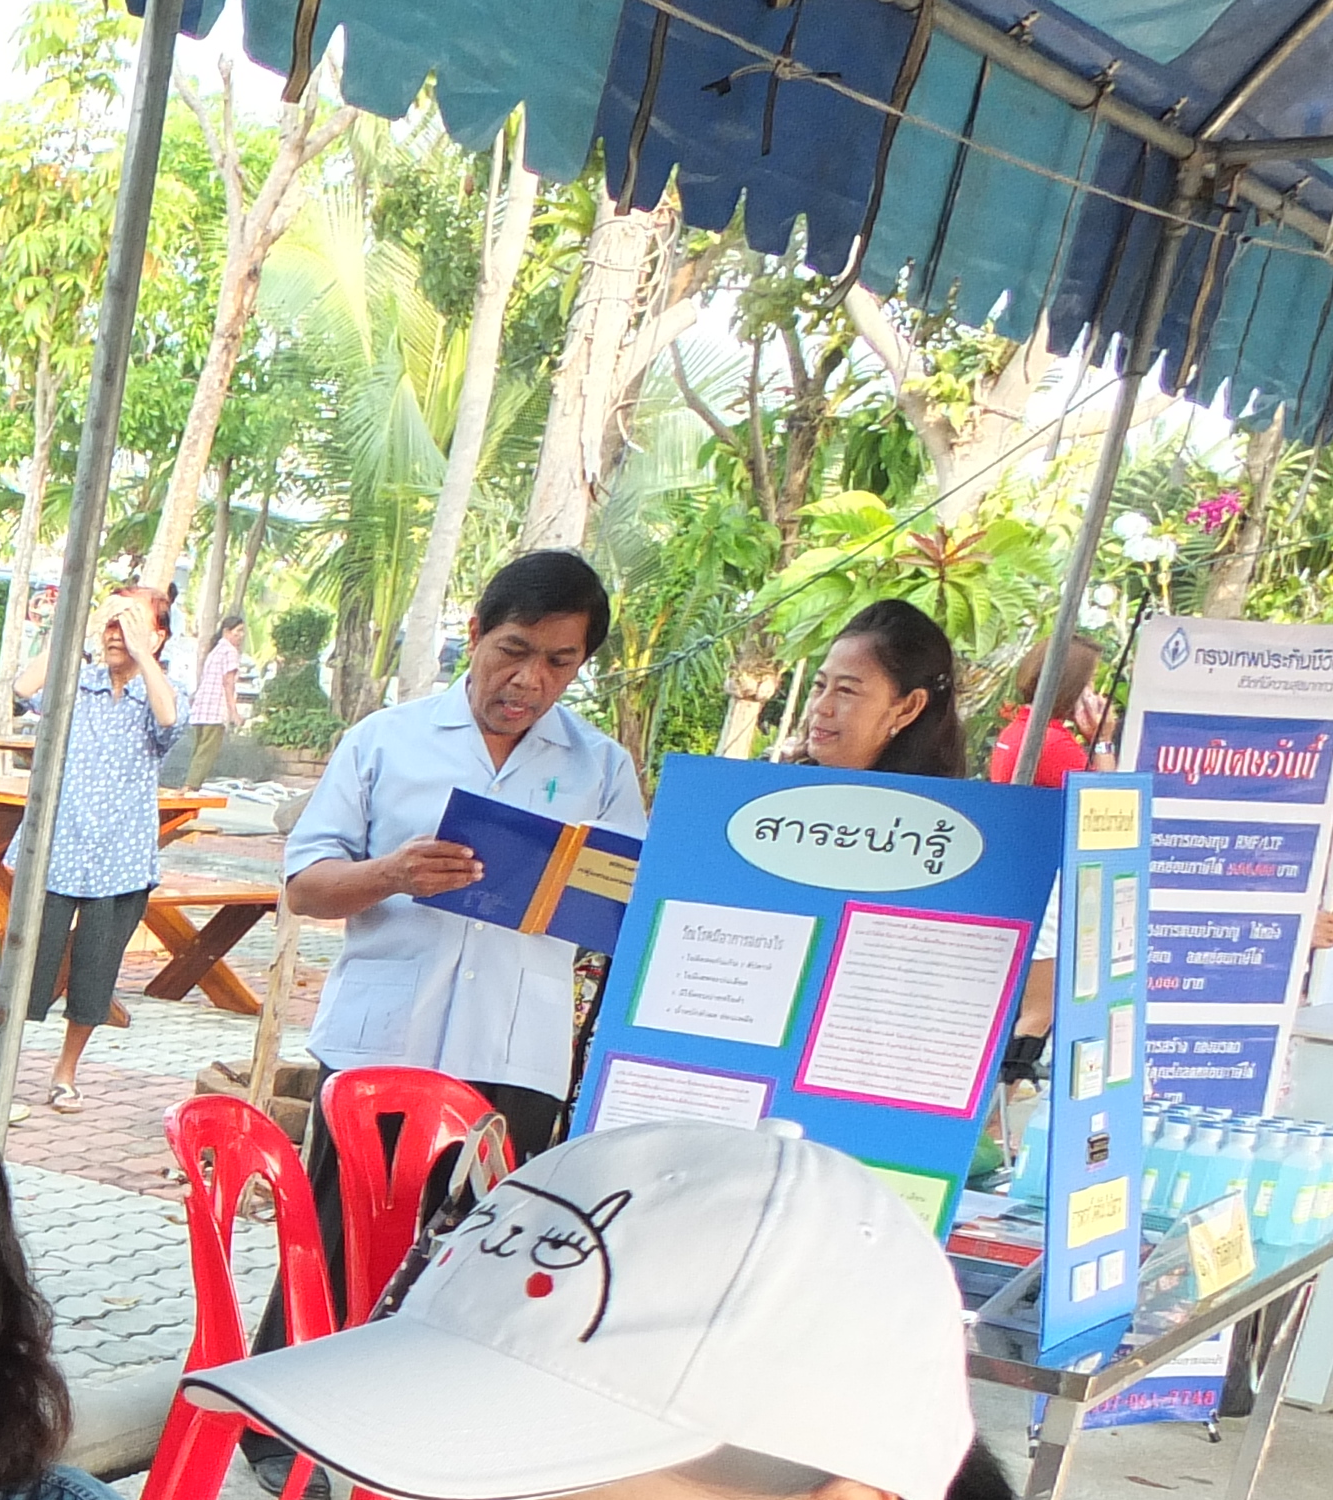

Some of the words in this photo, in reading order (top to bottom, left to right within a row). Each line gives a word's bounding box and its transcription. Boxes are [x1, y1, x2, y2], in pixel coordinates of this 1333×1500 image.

[1157, 733, 1329, 785] เมนูพิเศษวันนี้
[755, 817, 955, 875] สาระน่ารู้
